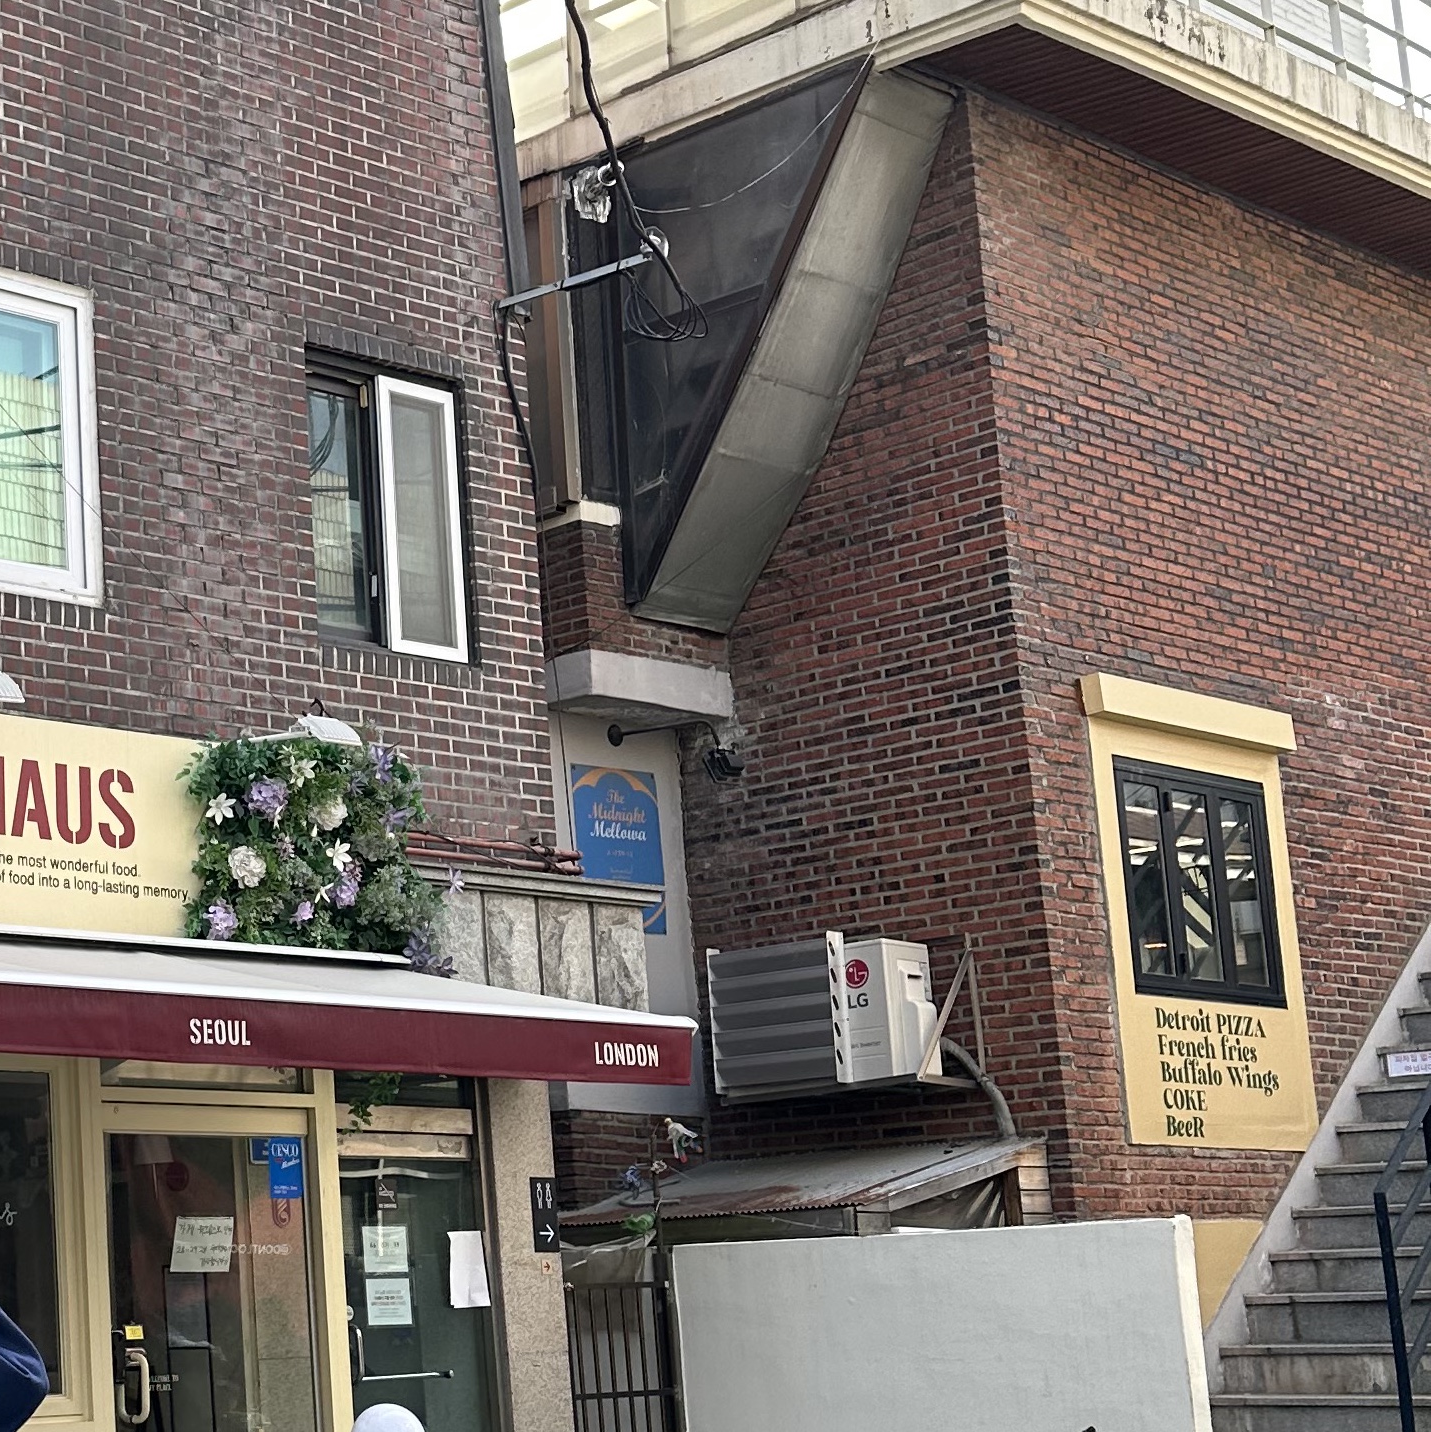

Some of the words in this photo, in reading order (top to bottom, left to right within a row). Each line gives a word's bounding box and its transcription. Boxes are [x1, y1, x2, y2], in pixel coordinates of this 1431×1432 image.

[588, 803, 648, 827] Midnight
[18, 854, 47, 869] most
[50, 857, 109, 875] wonderful
[9, 870, 35, 886] food
[38, 872, 60, 888] into
[63, 878, 71, 890] a
[74, 876, 140, 899] long-lasting
[847, 992, 869, 1010] LG
[189, 1018, 251, 1046] SEOUL
[1155, 1007, 1212, 1033] Detroit
[1216, 1013, 1267, 1039] PIZZA
[594, 1041, 659, 1068] LONDON
[1157, 1034, 1217, 1060] French
[1221, 1035, 1258, 1063] fries
[1160, 1058, 1223, 1086] Buffalo
[1226, 1065, 1280, 1097] Wings
[1163, 1088, 1209, 1112] COKE
[1166, 1114, 1206, 1138] BeeR
